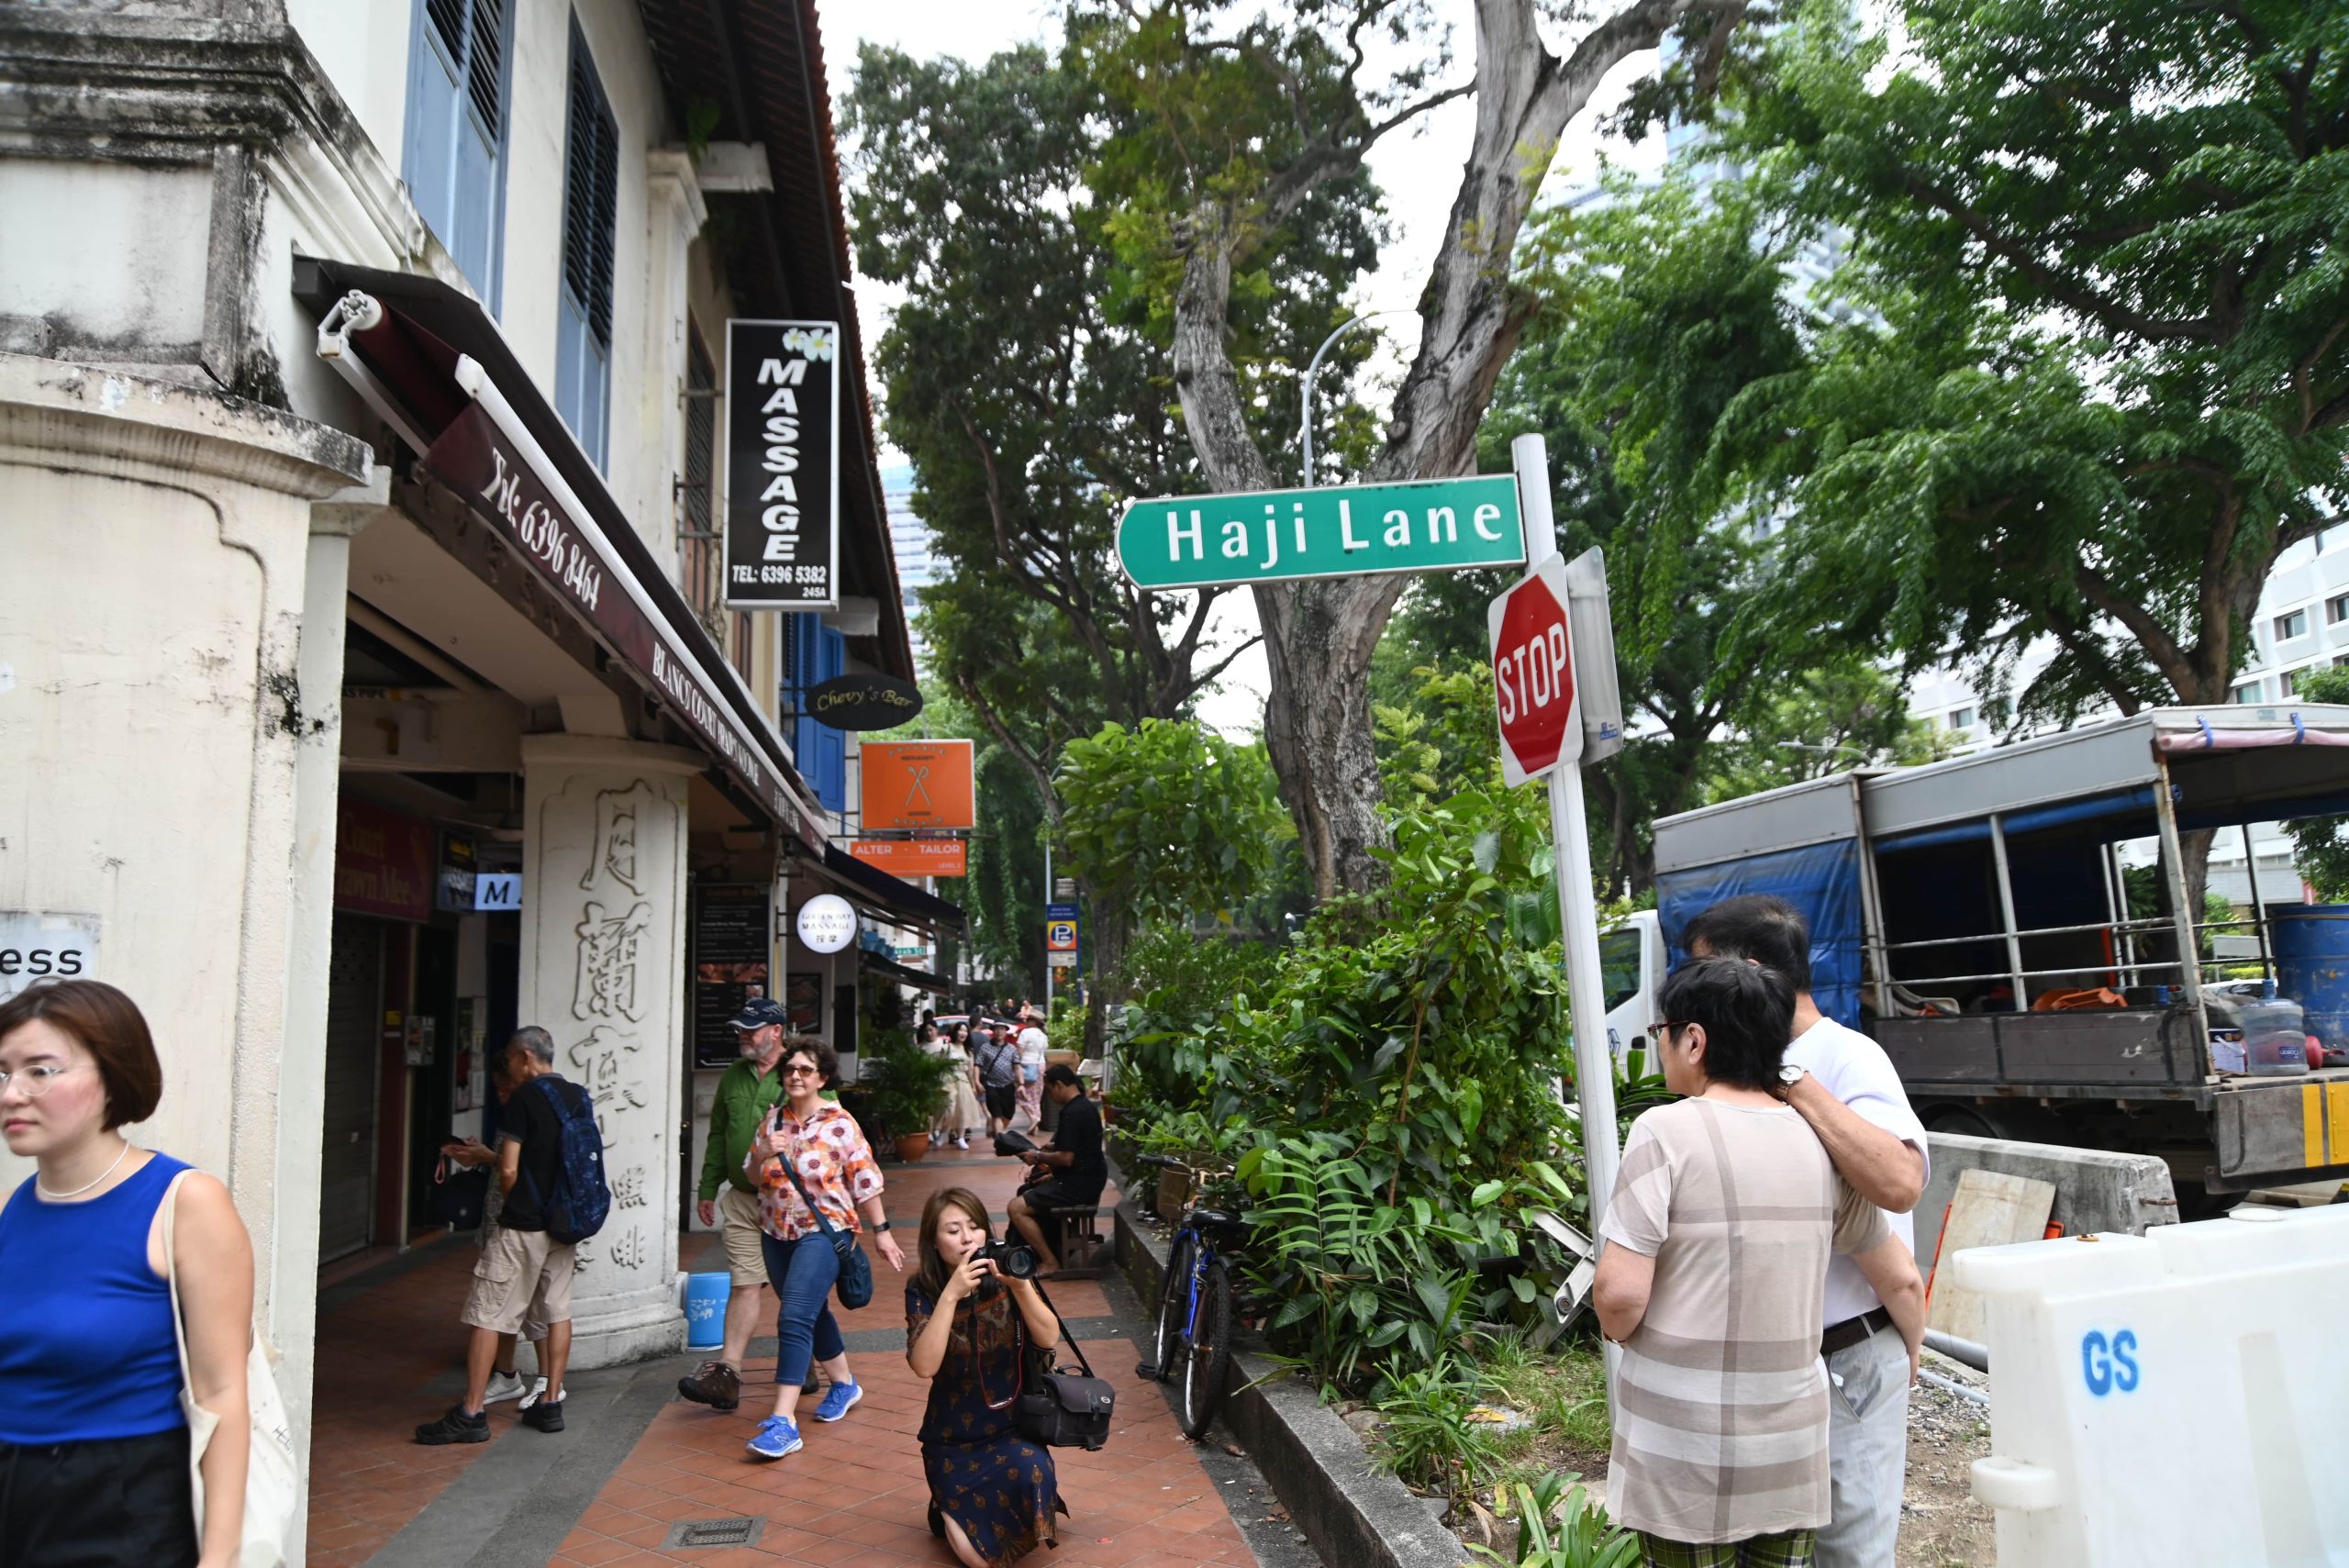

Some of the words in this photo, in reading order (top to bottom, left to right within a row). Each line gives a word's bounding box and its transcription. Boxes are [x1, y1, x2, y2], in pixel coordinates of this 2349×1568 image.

[757, 359, 807, 561] MASSAGE
[480, 447, 521, 528] Tel:
[520, 500, 569, 574] 6396
[563, 543, 601, 612] 8464
[1166, 503, 1308, 569] Haji
[1339, 499, 1503, 550] Lane
[732, 565, 758, 584] TEL:
[761, 565, 793, 584] 6396
[795, 565, 826, 584] 5382
[802, 586, 826, 598] 245A
[1497, 622, 1567, 726] STOP
[881, 689, 914, 707] Bar
[855, 845, 892, 854] ALTER
[919, 844, 960, 854] TAILOR
[336, 866, 378, 901] rawn
[0, 949, 83, 975] ess
[2082, 1329, 2138, 1396] GS
